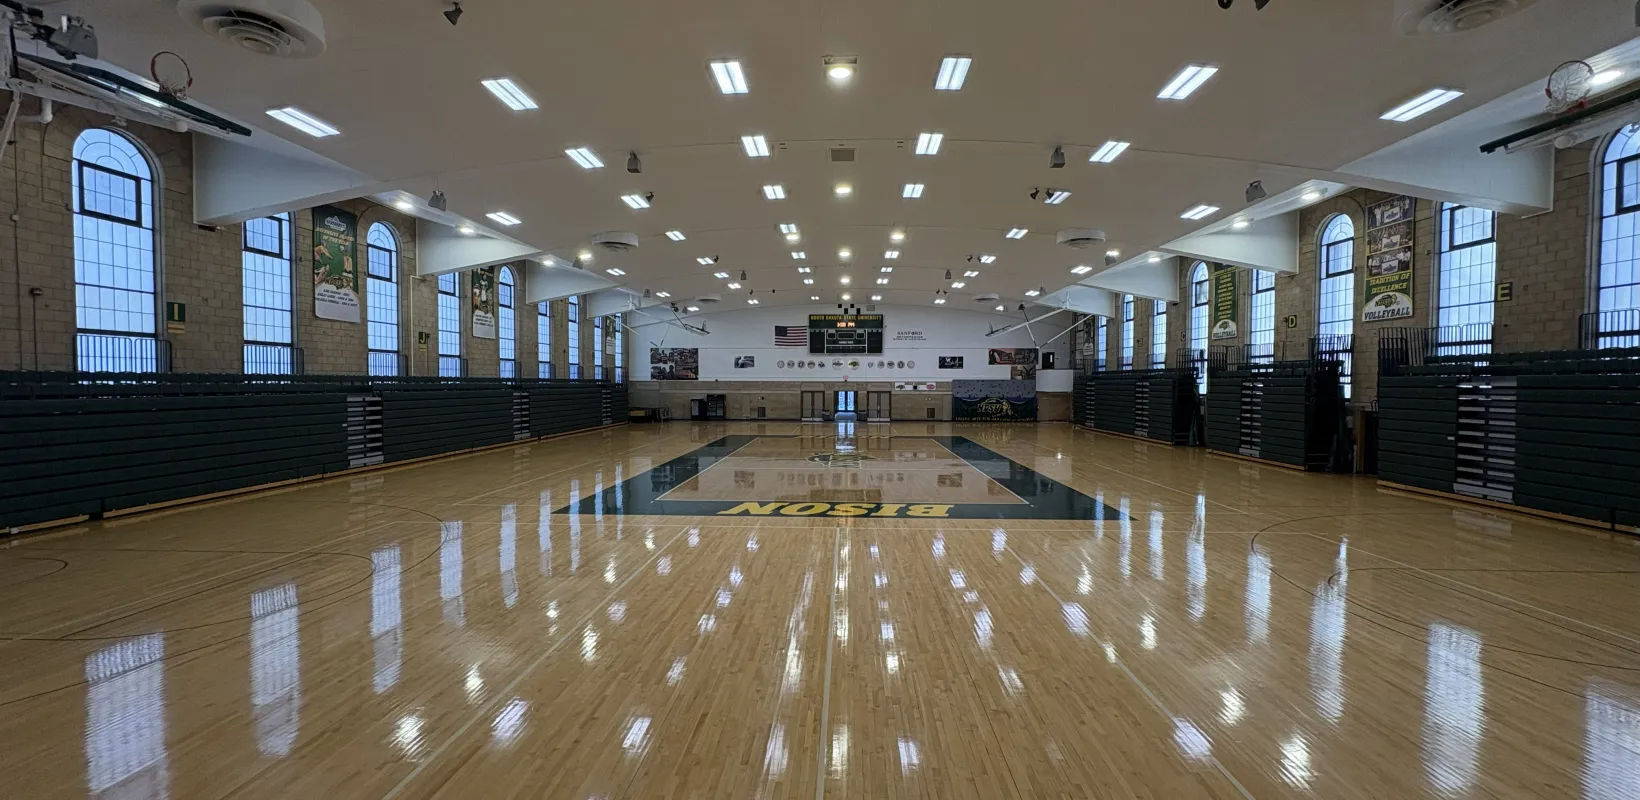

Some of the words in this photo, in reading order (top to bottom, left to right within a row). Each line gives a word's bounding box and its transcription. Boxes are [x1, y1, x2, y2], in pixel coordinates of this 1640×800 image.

[1370, 275, 1399, 285] TRADITION
[1497, 283, 1510, 300] E
[1364, 307, 1410, 320] VOLLEYBALL
[1288, 315, 1296, 328] D
[716, 501, 955, 517] BISON
